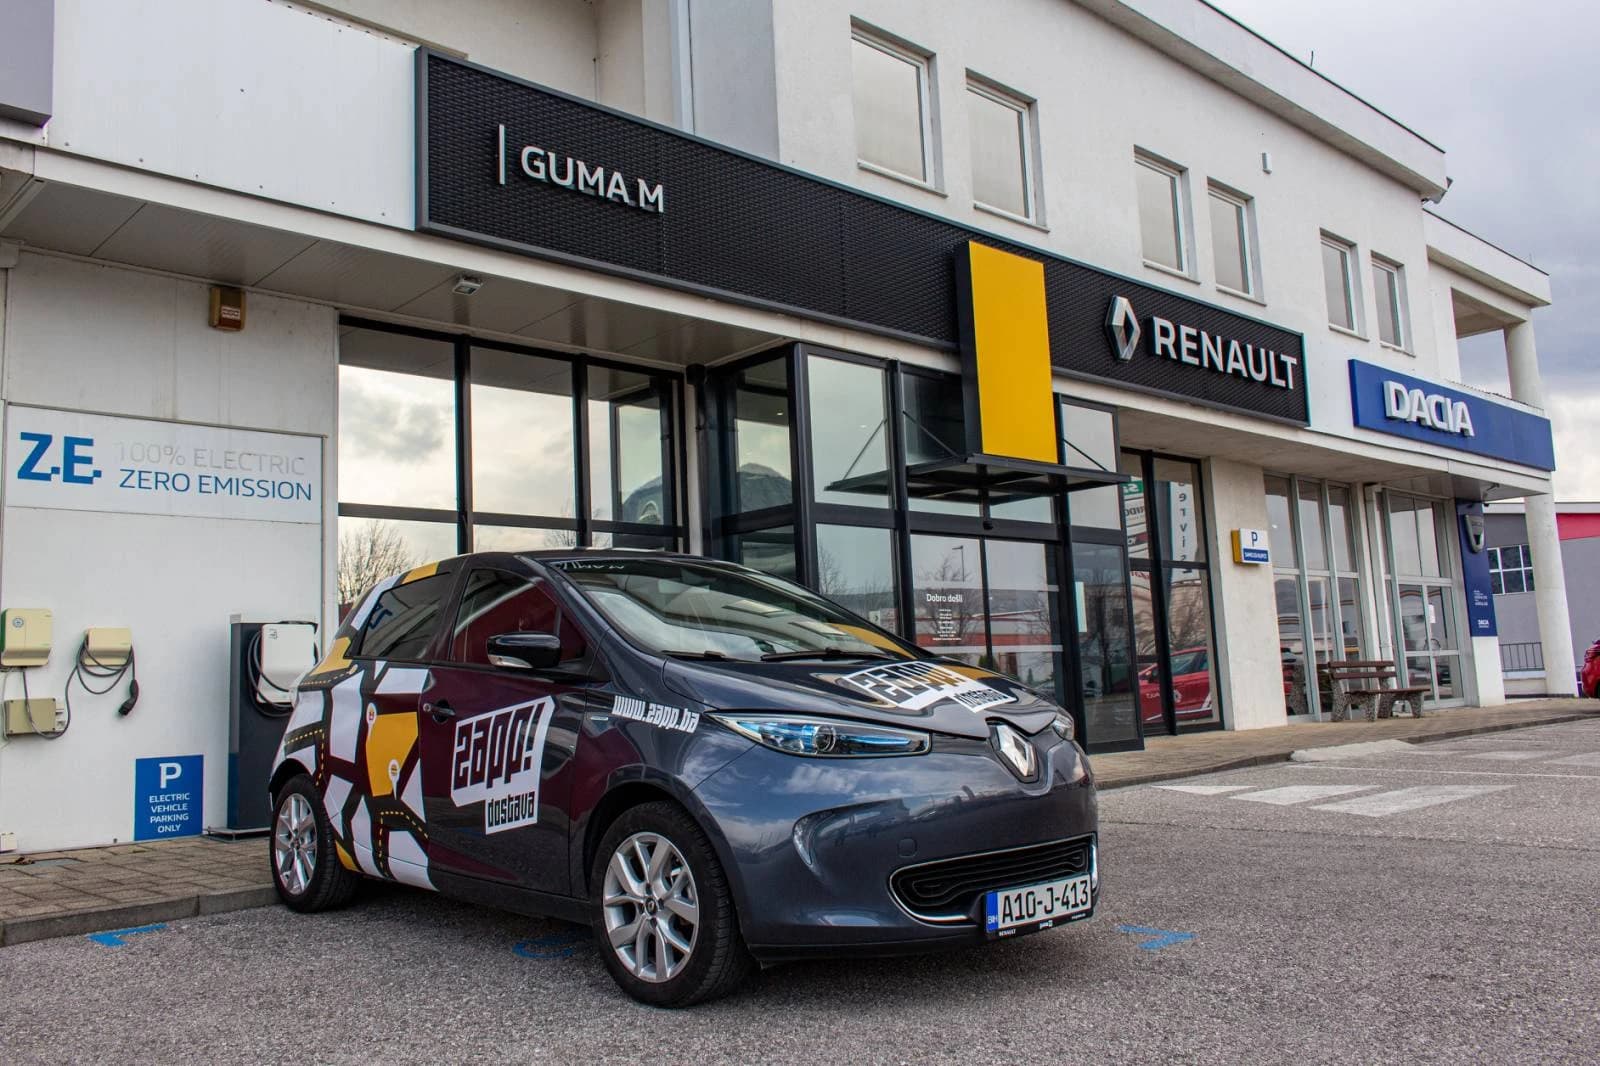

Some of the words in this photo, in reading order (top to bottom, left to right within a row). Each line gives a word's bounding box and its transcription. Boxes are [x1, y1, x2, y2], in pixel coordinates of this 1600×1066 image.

[520, 145, 630, 204] GUMA
[637, 177, 664, 213] M
[1152, 315, 1298, 390] RENAULT
[1383, 380, 1475, 437] DACIA
[115, 440, 186, 467] 100%
[193, 447, 305, 476] ELECTRIC
[119, 468, 190, 493] ZERO
[199, 475, 312, 501] EMISSION
[1250, 531, 1258, 548] P
[926, 593, 947, 602] Dobro
[611, 695, 700, 734] www.zapp.ba
[159, 762, 182, 789] P
[149, 793, 190, 803] ELECTRIC
[151, 803, 188, 813] VEHICLE
[487, 790, 536, 828] dostava
[150, 813, 189, 823] PARKING
[157, 824, 181, 833] ONLY
[1002, 880, 1089, 924] A10-J-413
